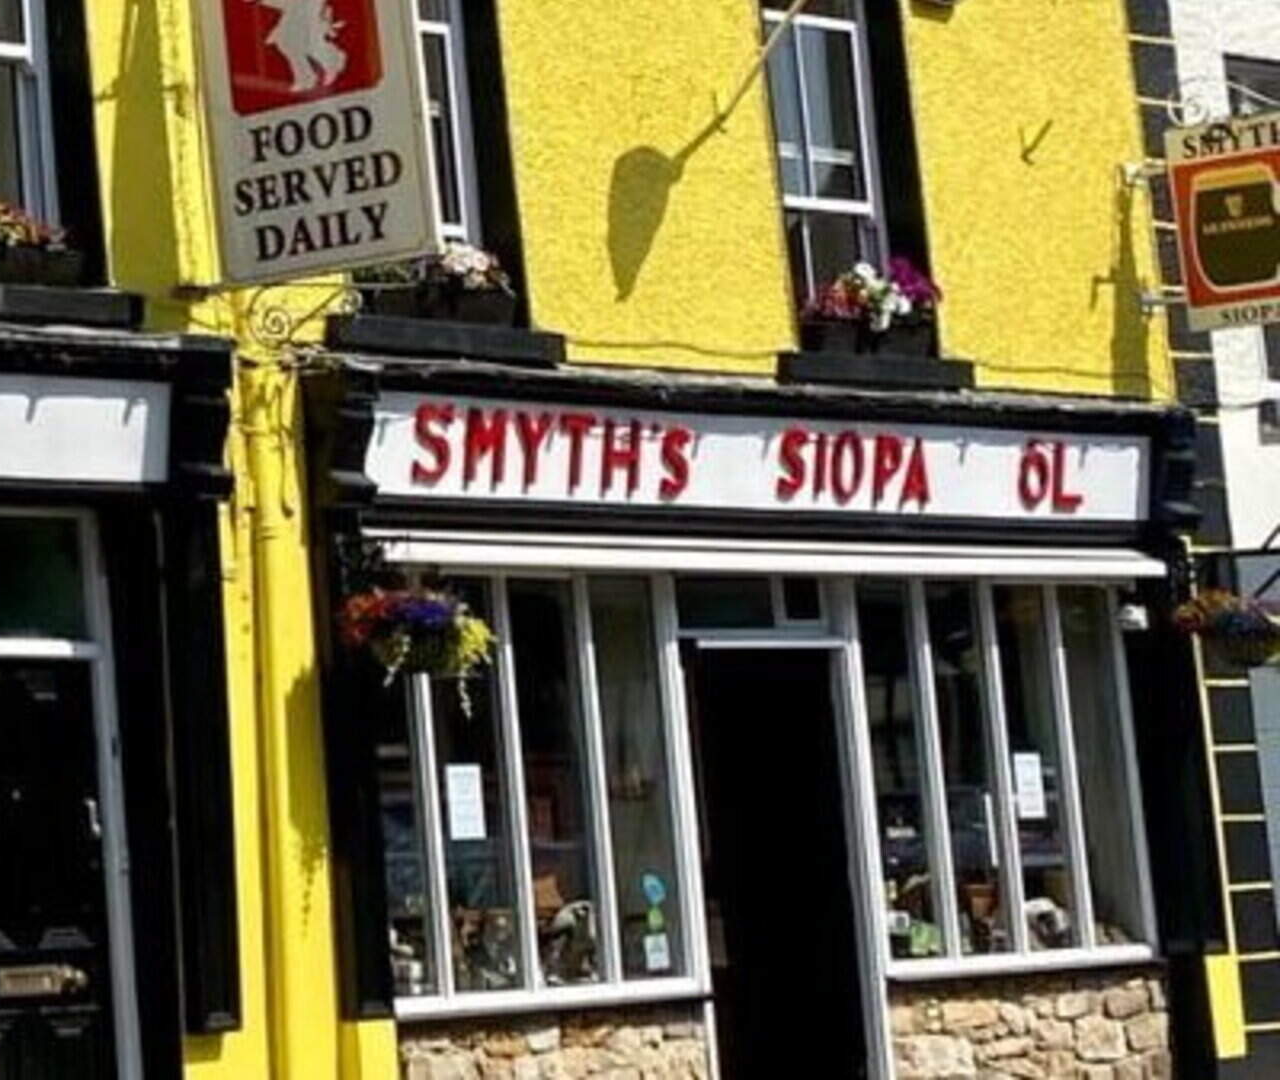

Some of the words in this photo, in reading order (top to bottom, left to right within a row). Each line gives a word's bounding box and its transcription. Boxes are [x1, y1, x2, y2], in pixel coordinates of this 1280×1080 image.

[250, 105, 374, 163] FOOD
[234, 150, 403, 218] SERVED
[256, 202, 389, 263] DAILY
[411, 403, 693, 501] SMYTH'S
[775, 429, 931, 512] SIOPA
